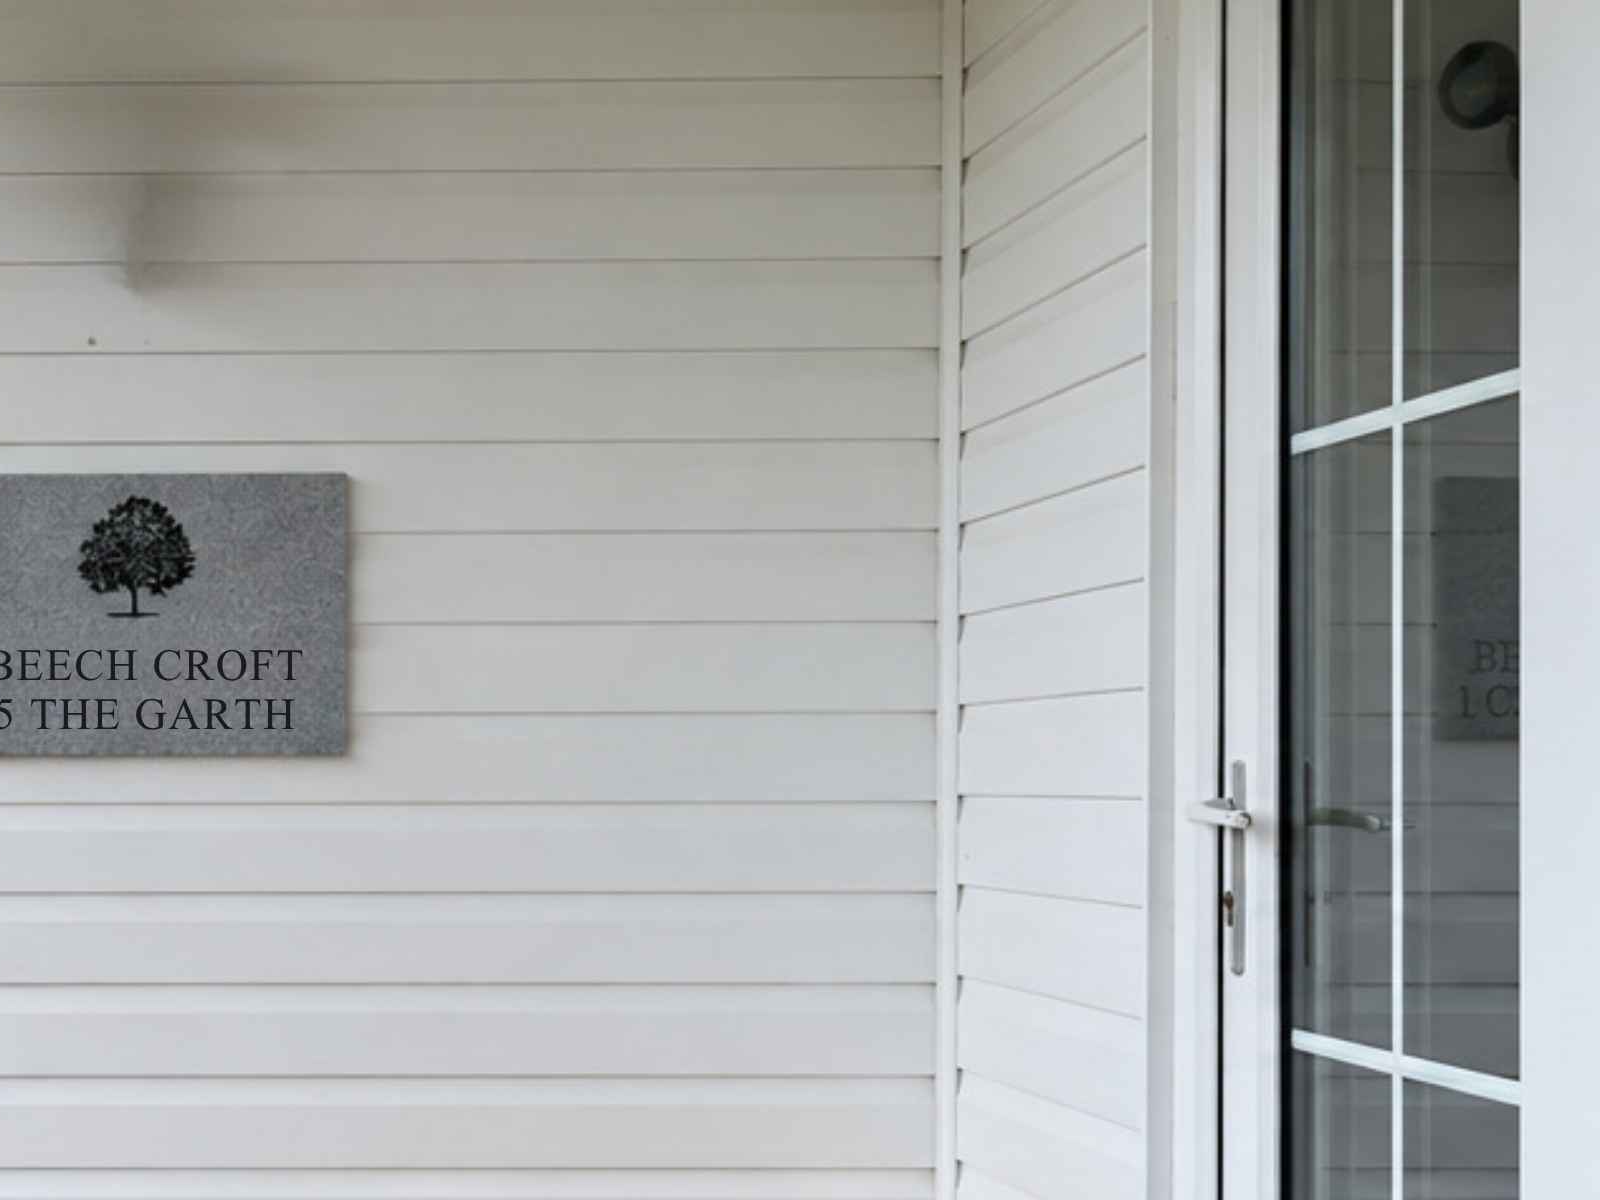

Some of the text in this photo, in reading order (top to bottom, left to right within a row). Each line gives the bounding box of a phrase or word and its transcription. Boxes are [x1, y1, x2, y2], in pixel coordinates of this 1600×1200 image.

[153, 649, 303, 682] CROFT
[30, 698, 120, 731] THE
[135, 698, 295, 731] GARTH
